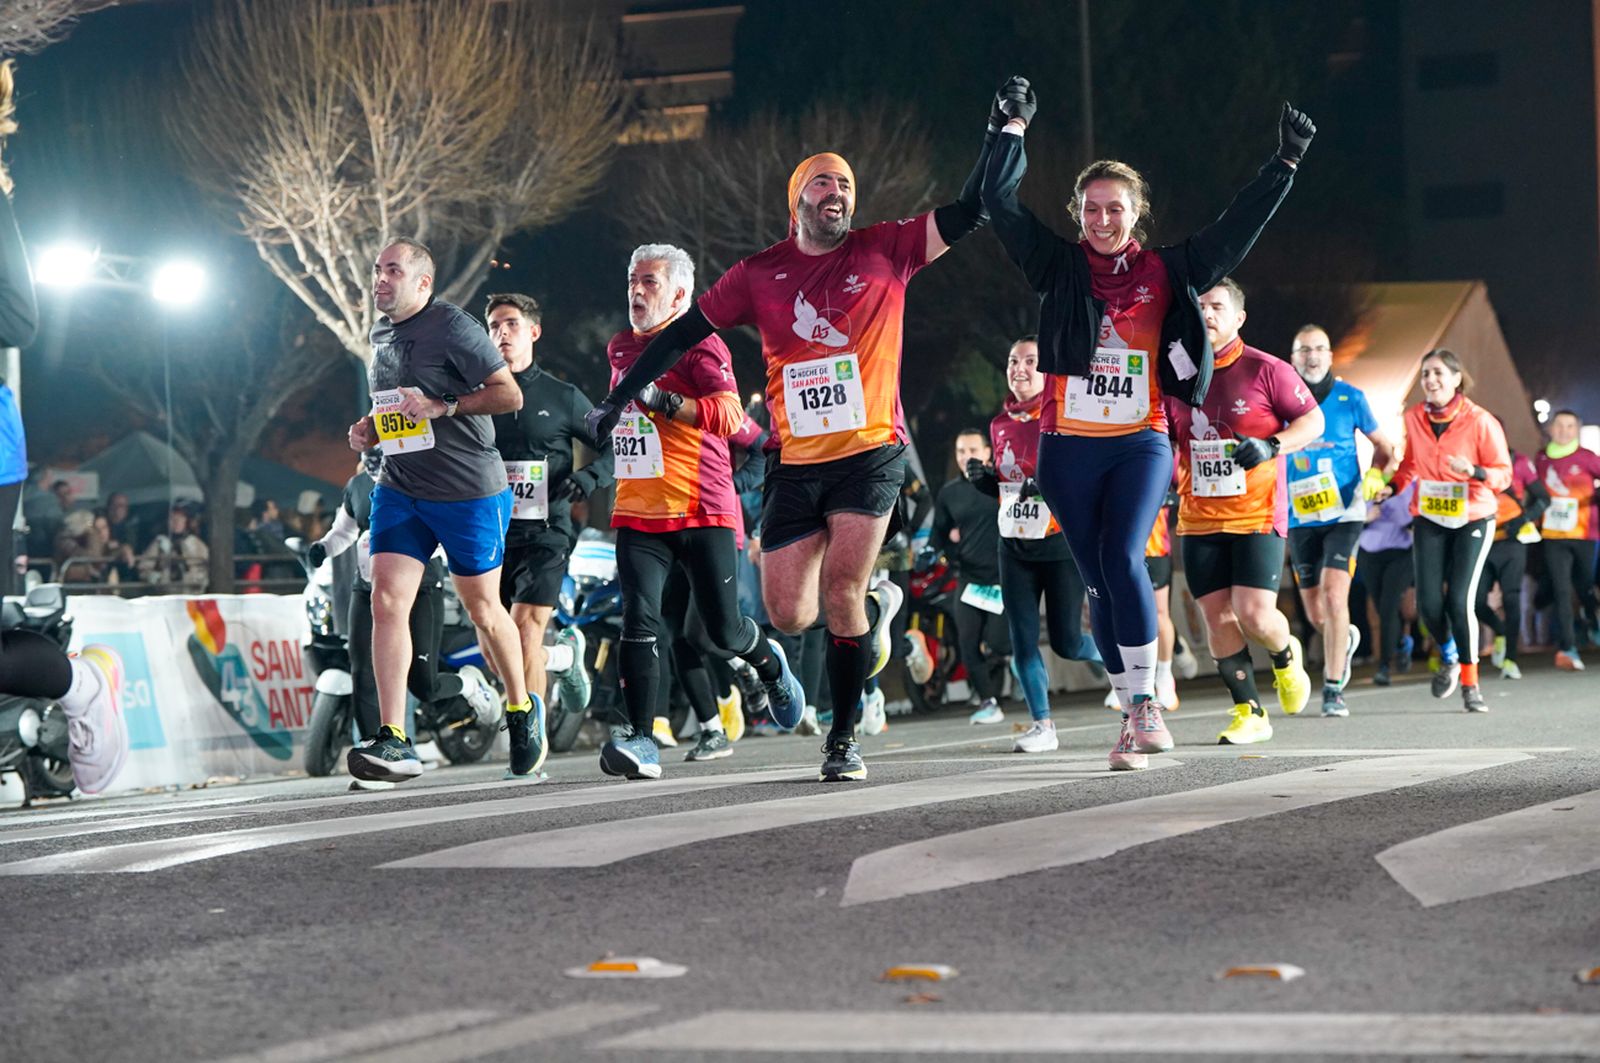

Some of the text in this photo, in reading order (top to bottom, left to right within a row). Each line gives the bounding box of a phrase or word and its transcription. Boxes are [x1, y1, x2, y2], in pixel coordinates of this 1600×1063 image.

[819, 366, 829, 375] DE
[1111, 356, 1121, 365] DE
[791, 379, 804, 389] SAN
[1082, 374, 1133, 398] 1844
[798, 383, 847, 411] 1328
[614, 436, 647, 456] 5321
[1300, 490, 1329, 510] 3847
[1427, 497, 1458, 512] 3848
[251, 640, 303, 681] SAN
